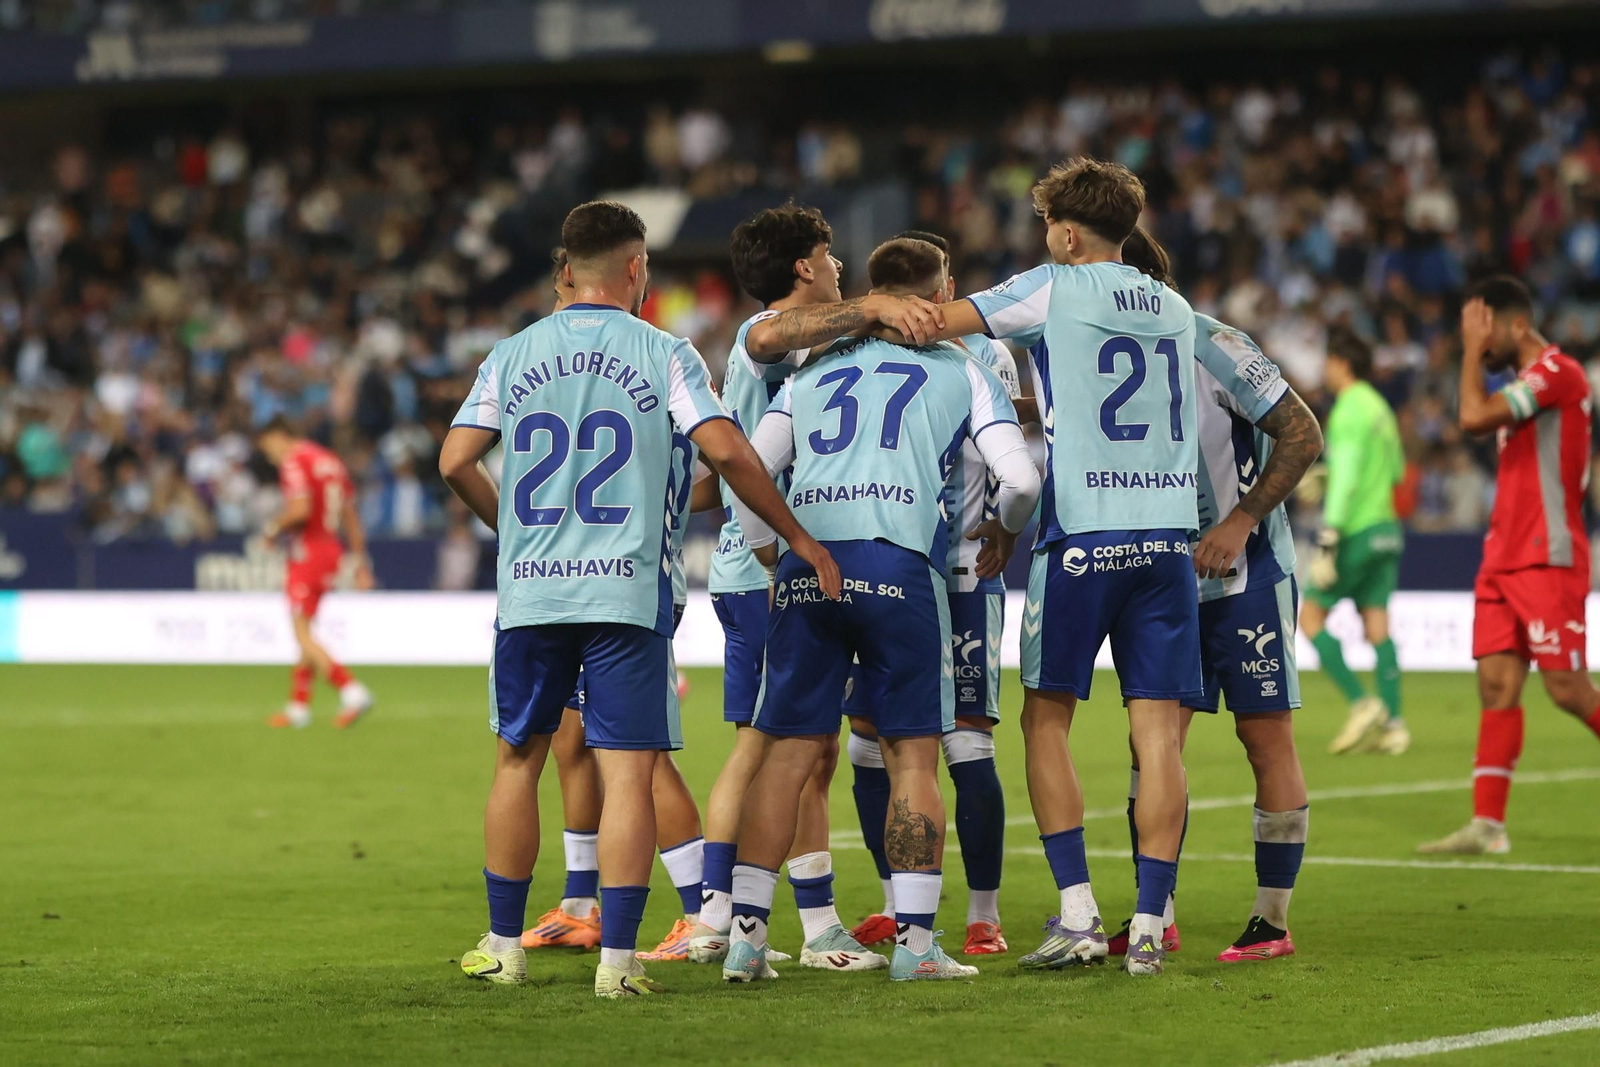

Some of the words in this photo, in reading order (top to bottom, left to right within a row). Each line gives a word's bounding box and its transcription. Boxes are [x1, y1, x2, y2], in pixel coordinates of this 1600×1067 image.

[1112, 285, 1162, 316] NIÑO
[555, 350, 660, 414] LORENZO
[1098, 336, 1185, 442] 21
[808, 361, 929, 455] 37
[513, 411, 634, 527] 22
[792, 482, 915, 509] BENAHAVIS
[1092, 543, 1140, 559] COSTA
[1143, 540, 1171, 553] DEL
[512, 558, 635, 580] BENAHAVIS
[1093, 555, 1152, 573] MÁLAGA
[790, 576, 819, 591] COS
[843, 578, 874, 594] DEL
[876, 583, 906, 600] SOL
[1241, 658, 1280, 674] MGS
